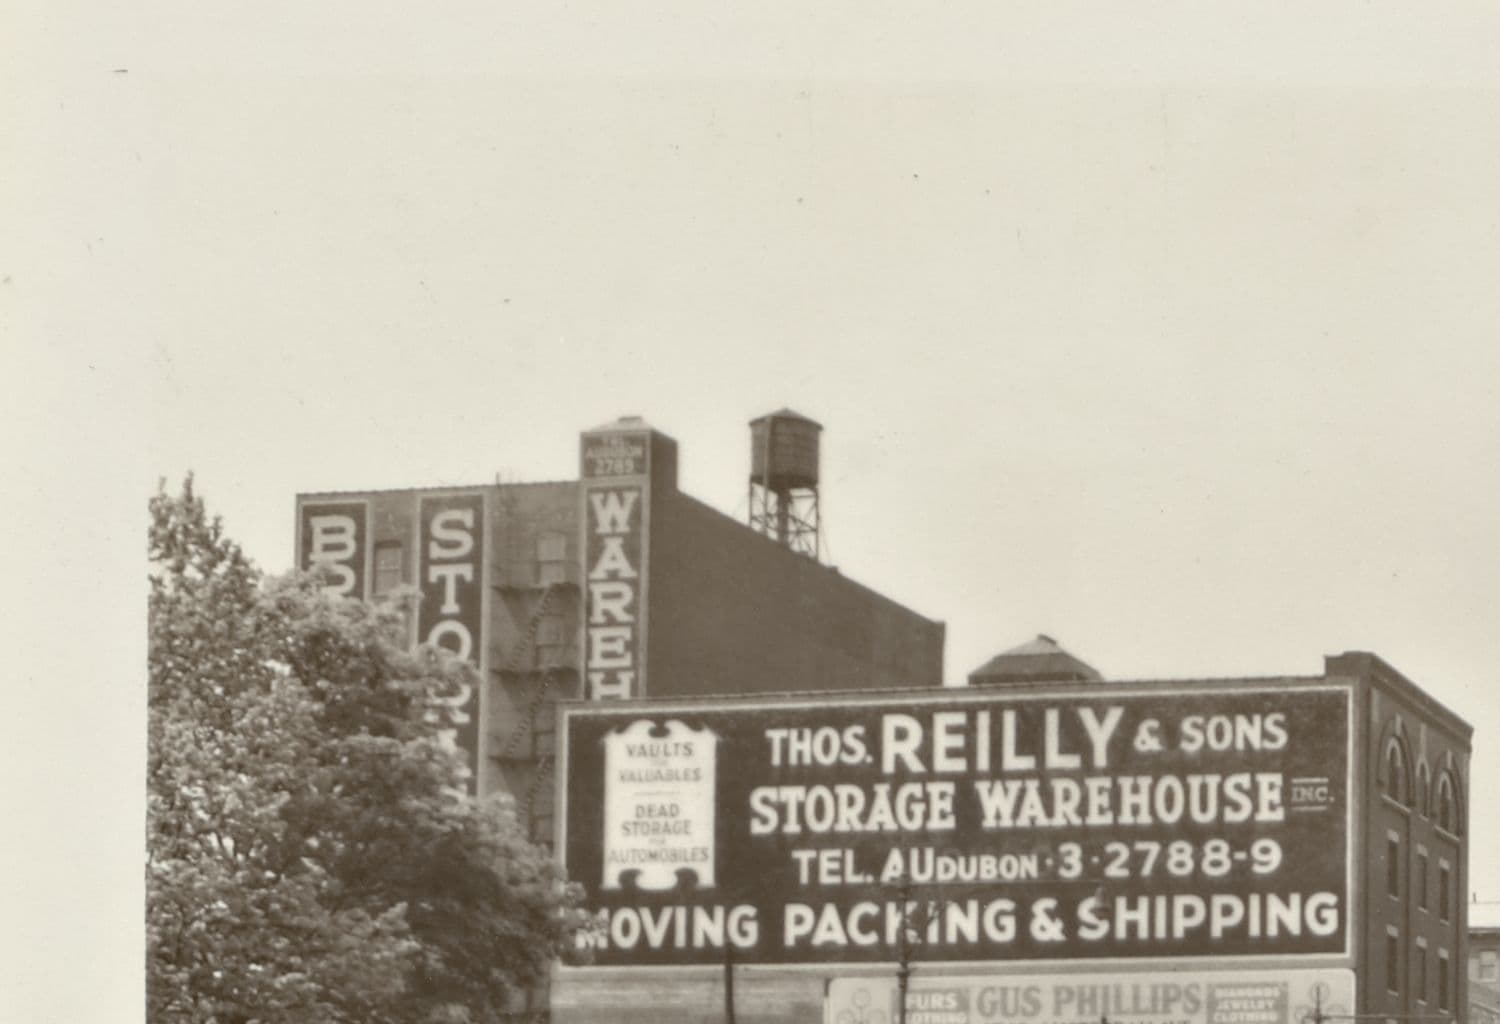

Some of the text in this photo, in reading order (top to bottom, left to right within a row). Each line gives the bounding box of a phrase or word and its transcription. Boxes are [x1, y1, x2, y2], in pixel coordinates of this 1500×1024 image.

[625, 742, 694, 758] VAULTS
[766, 706, 1289, 775] THOS. REILLY & SONS
[618, 767, 702, 783] VALUABLES
[635, 803, 681, 819] DEAD
[749, 773, 1336, 836] STORAGE WAREHOUSE INC.
[621, 819, 693, 837] STORAGE
[608, 847, 710, 864] AUTOMOBILES
[791, 848, 873, 886] TEL.
[574, 892, 1340, 950] MOVING PACKING & SHIPPING
[905, 991, 958, 1011] FURS
[976, 982, 1202, 1018] GUS PHILLIPS
[1212, 1010, 1279, 1023] CLOTHING
